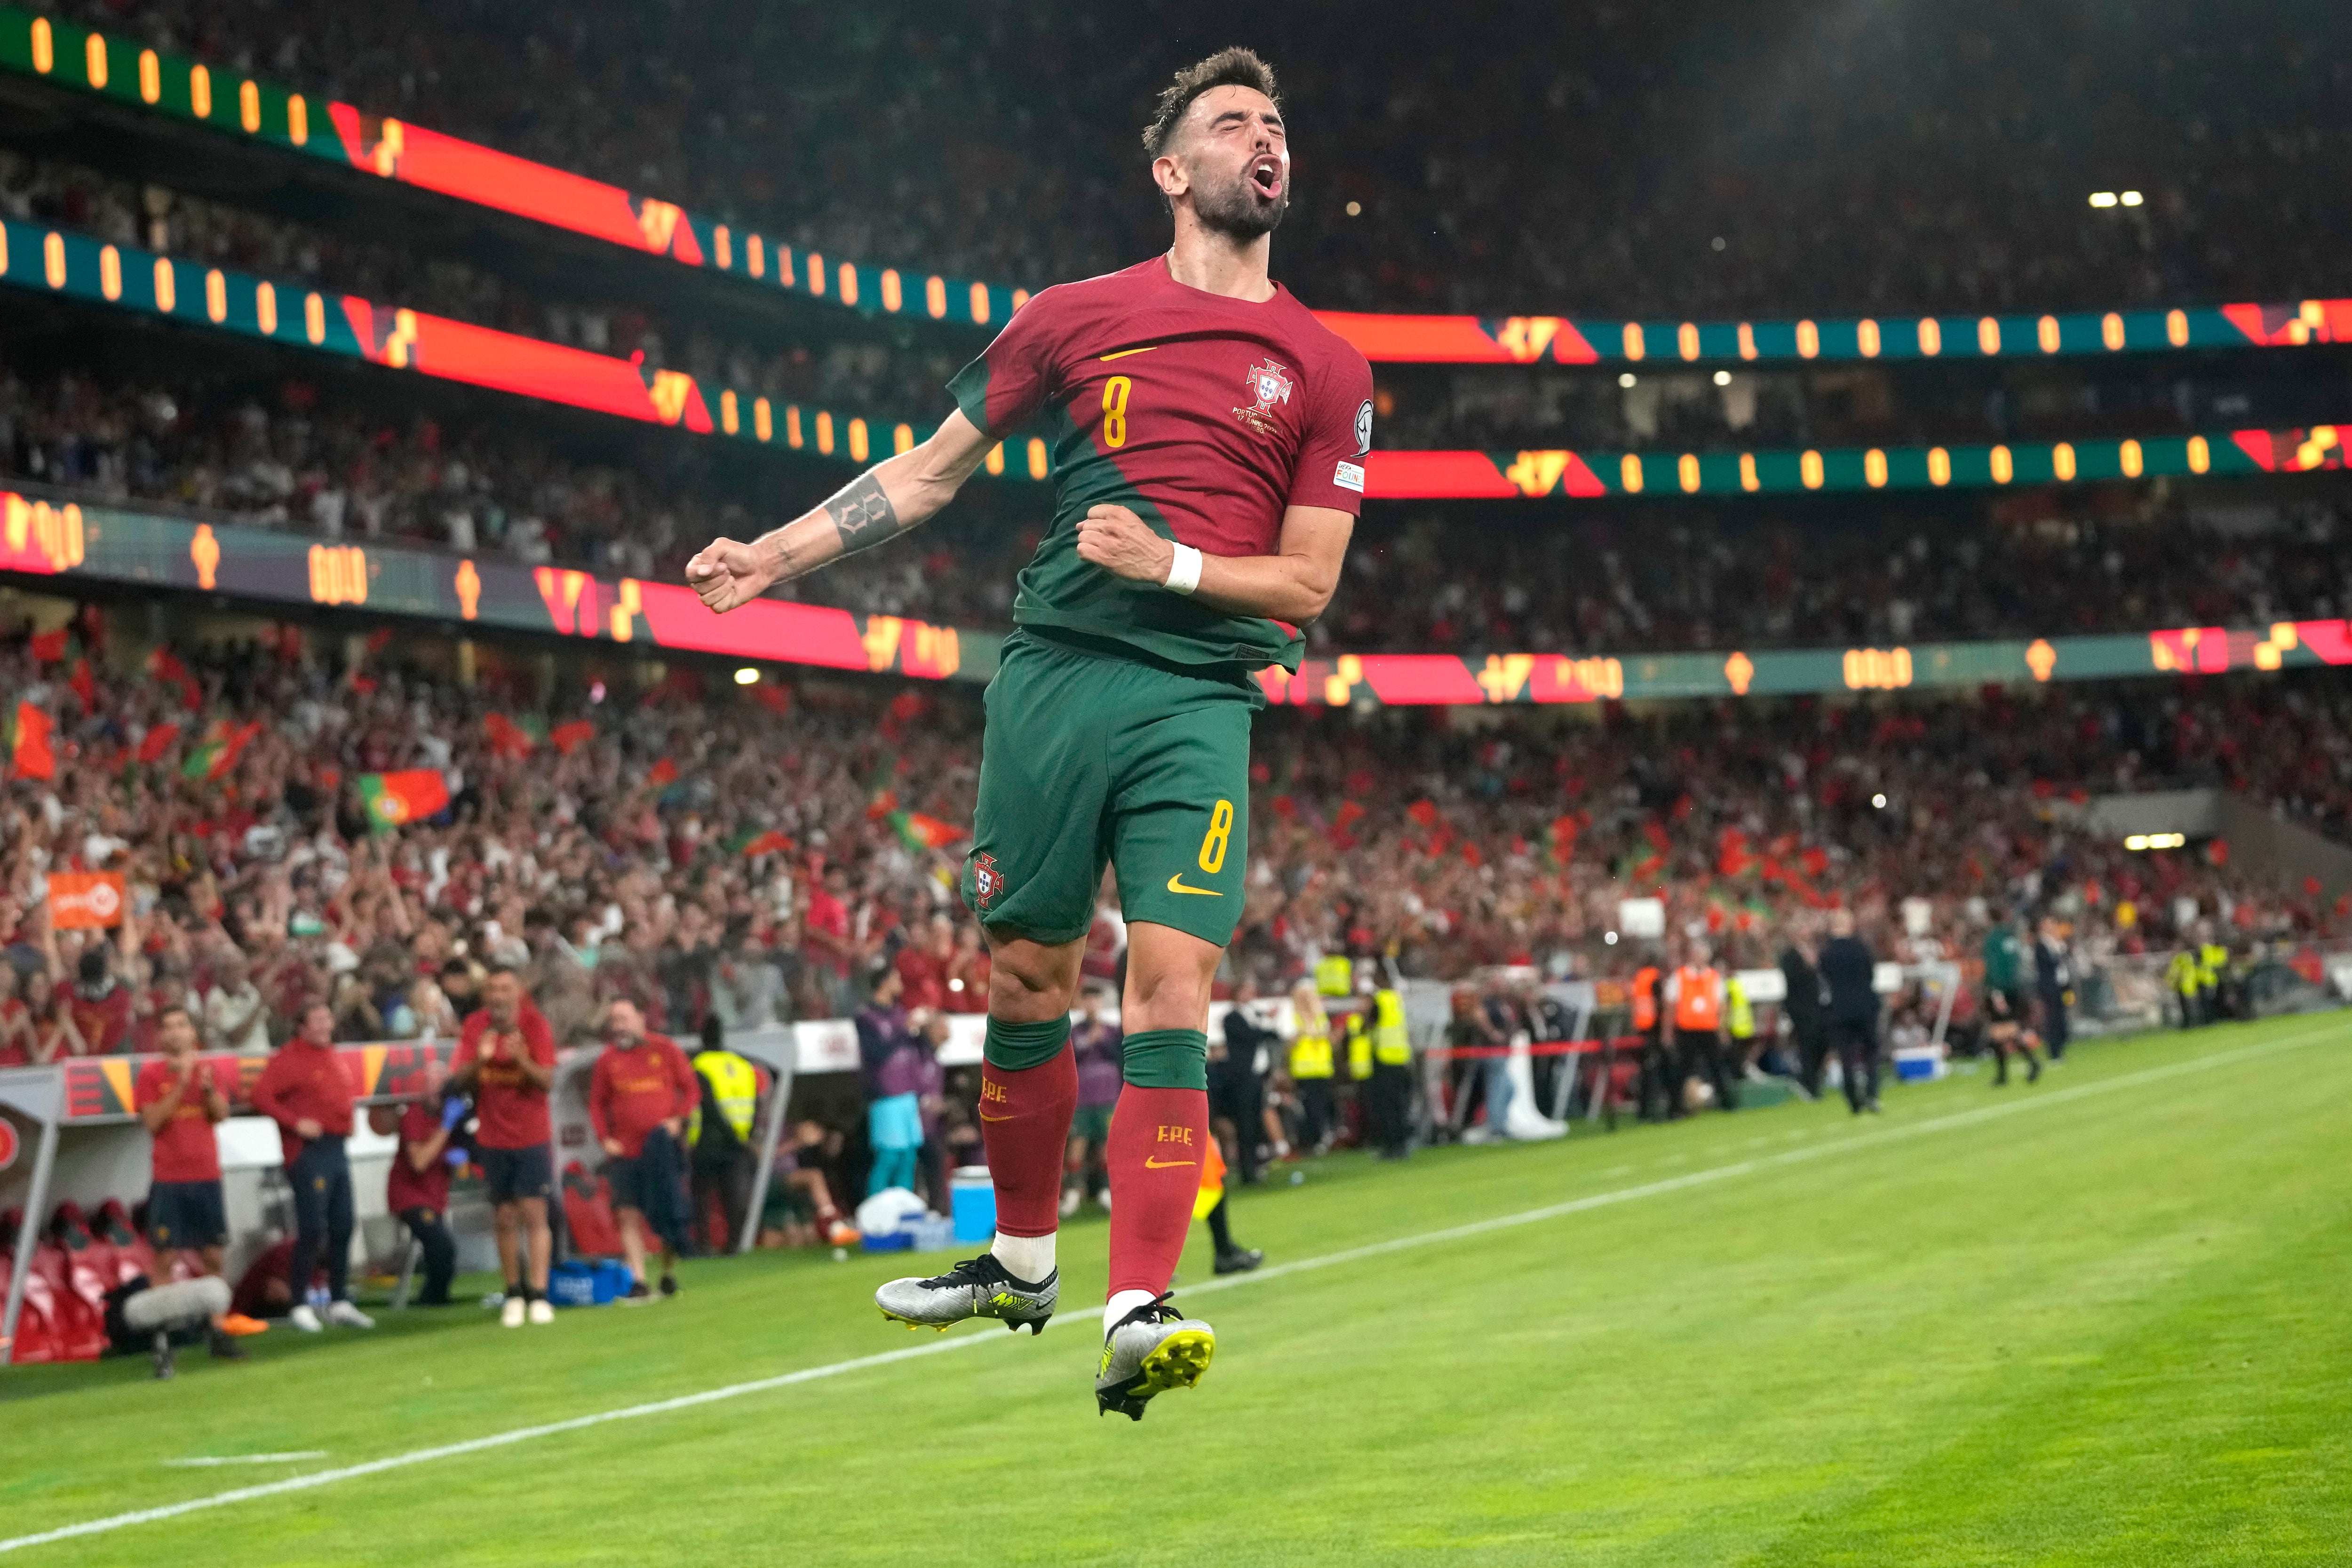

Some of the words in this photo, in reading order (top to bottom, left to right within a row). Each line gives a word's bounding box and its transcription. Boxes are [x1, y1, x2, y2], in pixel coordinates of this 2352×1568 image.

[1102, 376, 1132, 448] 8
[1245, 417, 1263, 427] JUNHO
[1198, 800, 1234, 874] 8
